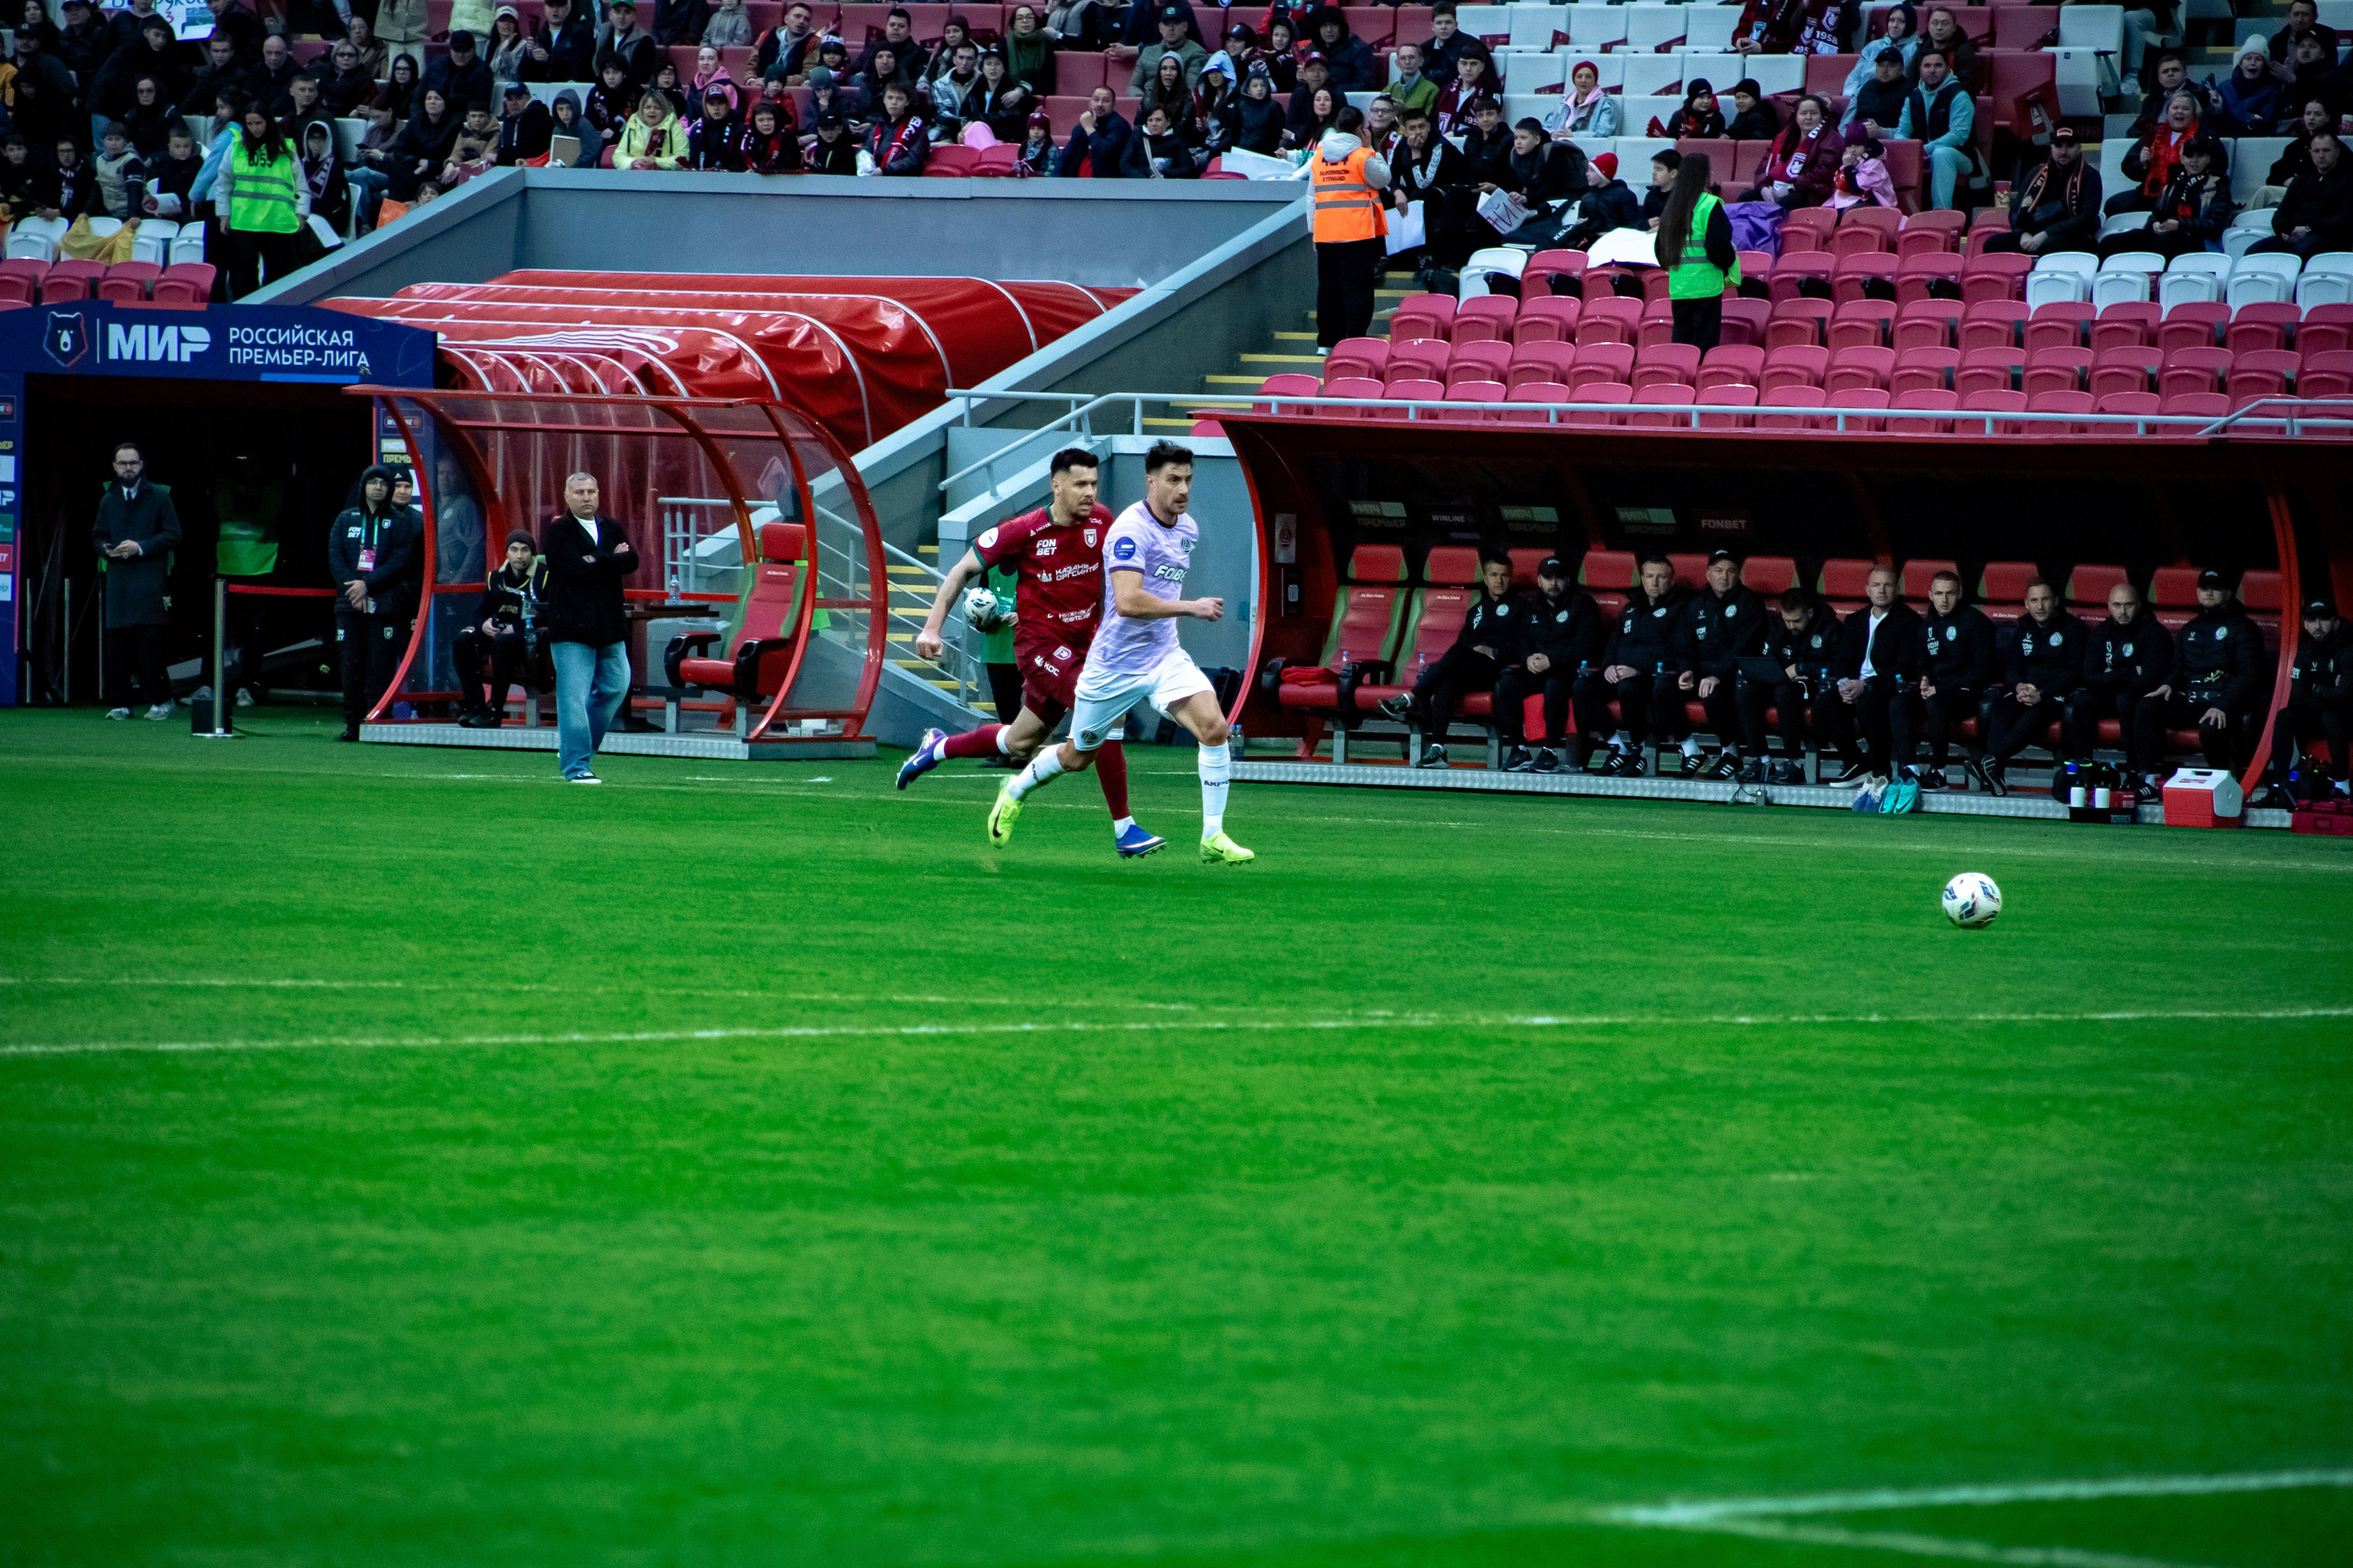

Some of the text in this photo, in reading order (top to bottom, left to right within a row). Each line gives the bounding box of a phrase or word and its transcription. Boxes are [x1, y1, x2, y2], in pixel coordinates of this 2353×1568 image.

[1815, 30, 1838, 45] 1958
[230, 324, 353, 347] РОССИЙСКАЯ
[108, 324, 211, 363] МИР
[230, 347, 369, 368] ПРЕМЬЕР-ЛИГА
[1431, 514, 1467, 523] WINLINE
[1700, 518, 1746, 529] FONBET
[1036, 539, 1057, 548] FON
[1036, 547, 1057, 556] BET
[1055, 563, 1089, 575] КАЗАНЬ
[1056, 562, 1098, 581] ОРГСИНТЕ
[2110, 814, 2131, 824] TORRES
